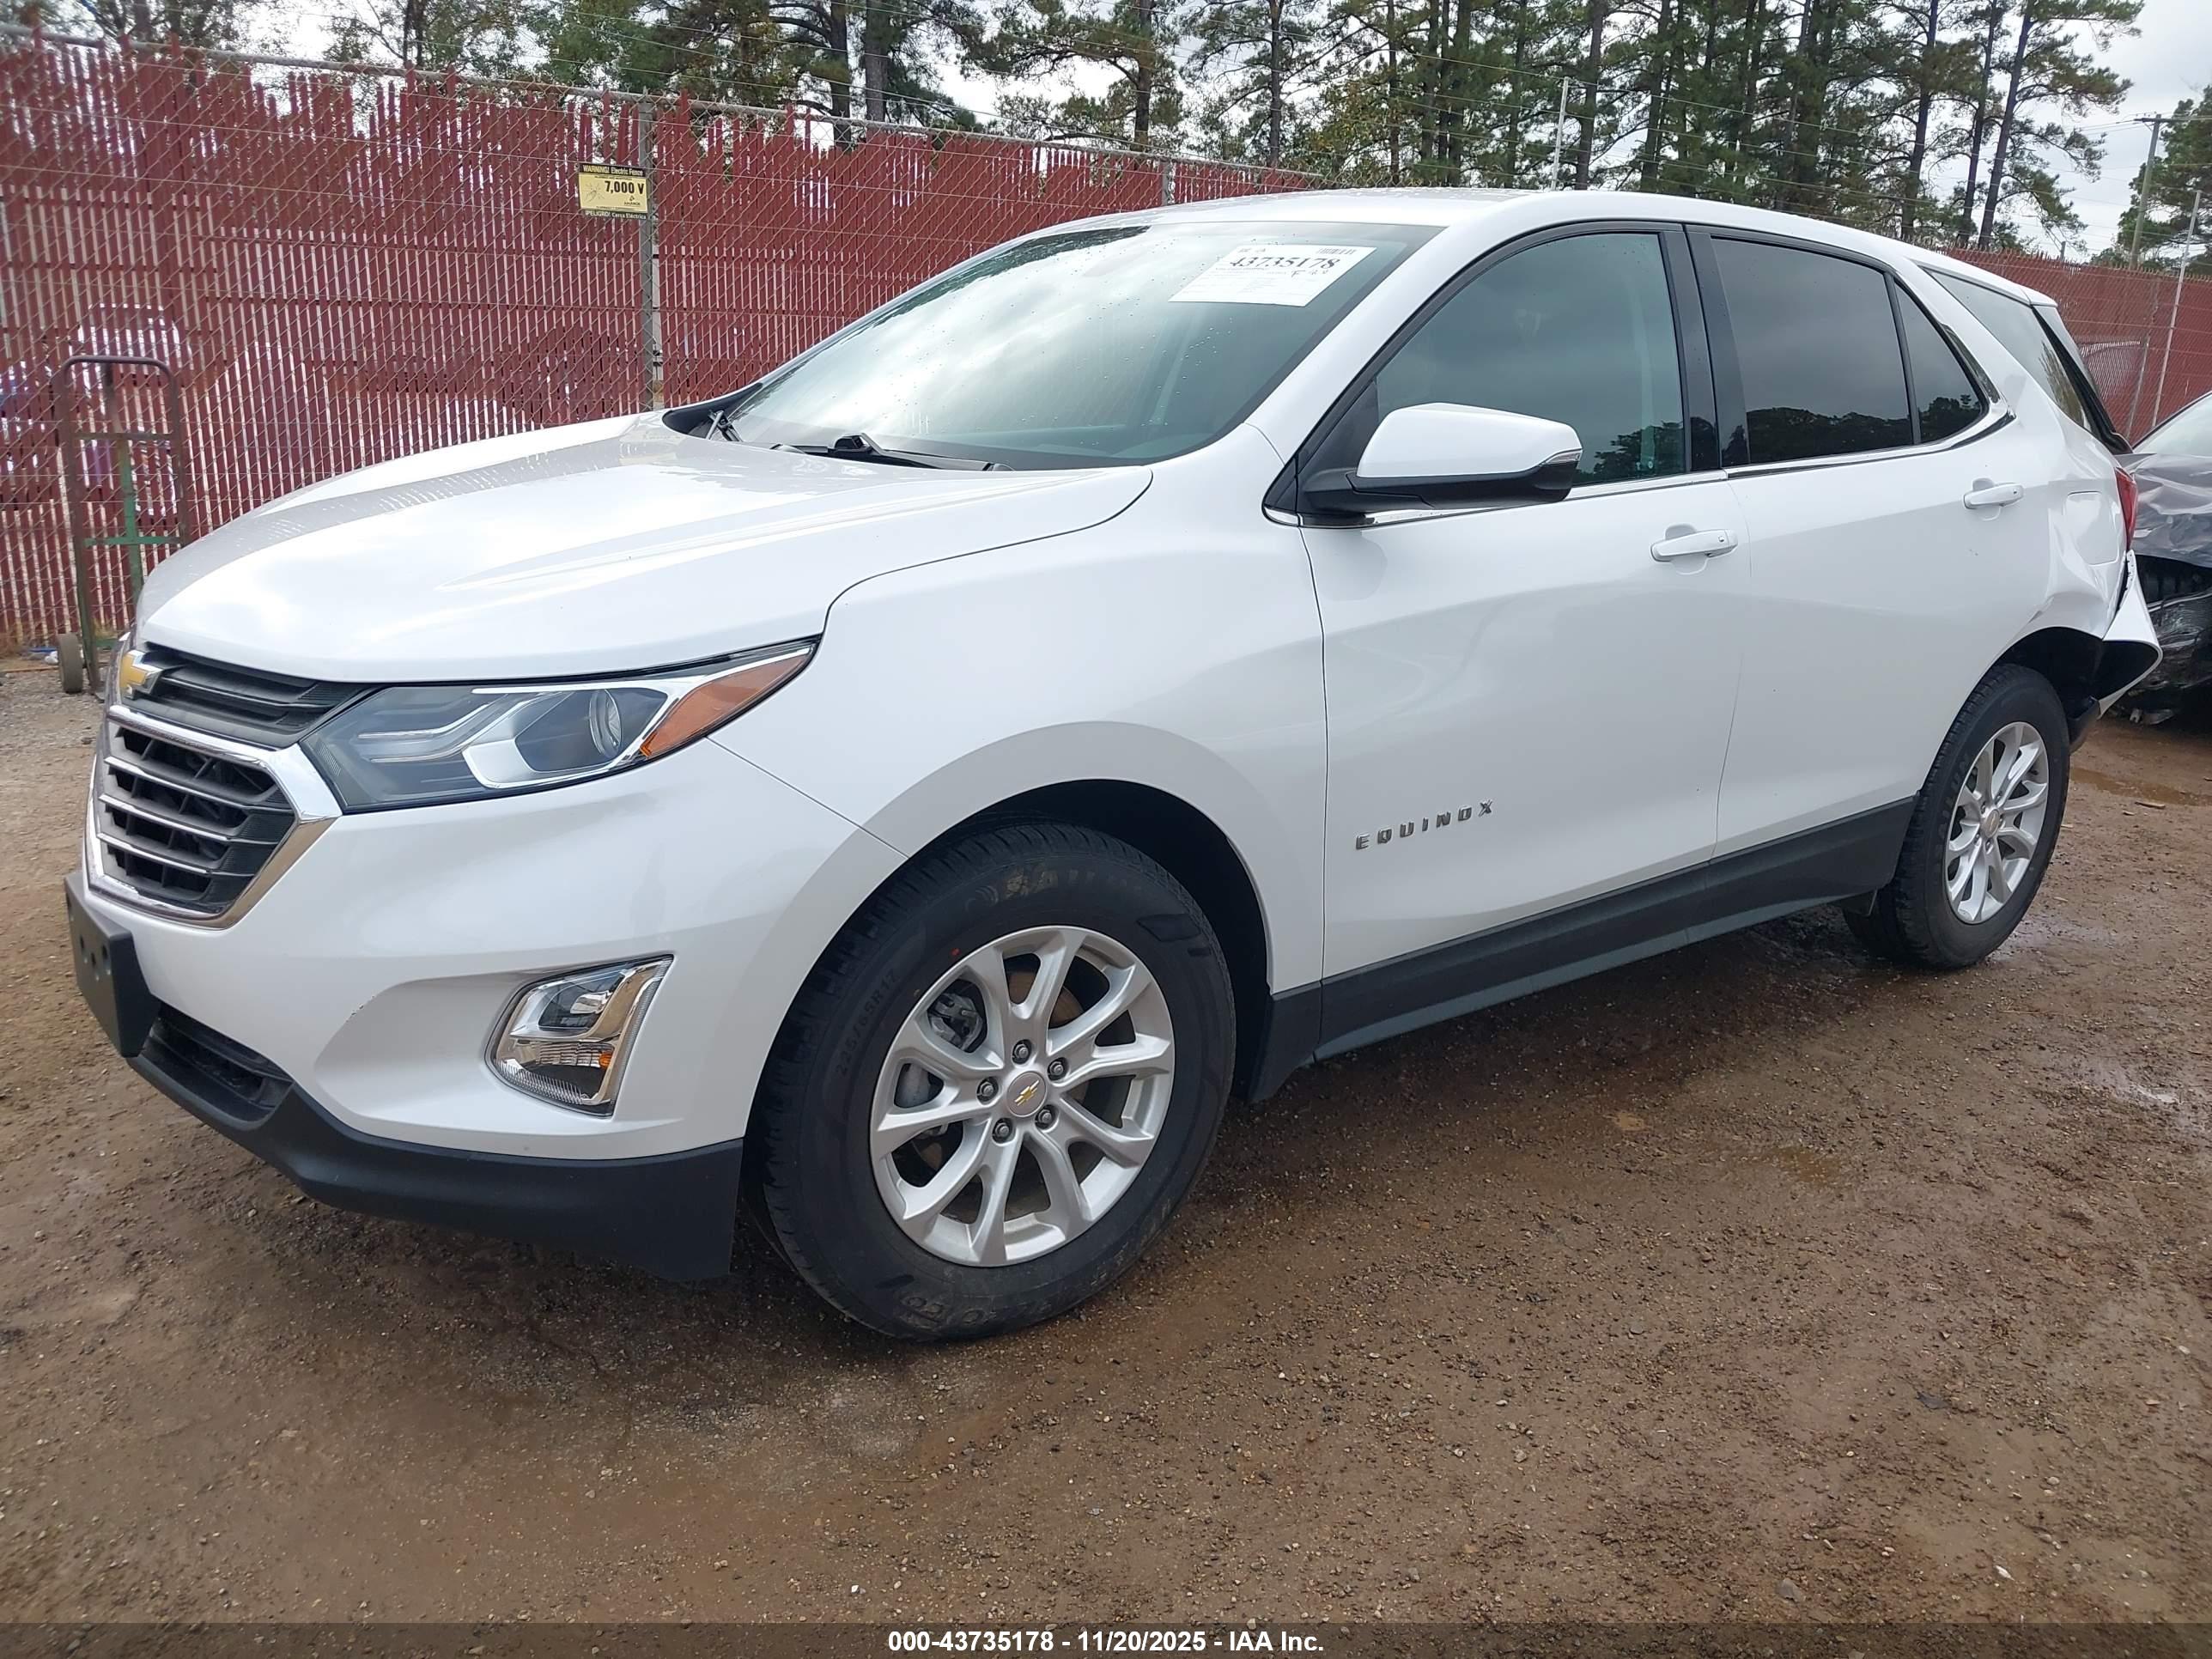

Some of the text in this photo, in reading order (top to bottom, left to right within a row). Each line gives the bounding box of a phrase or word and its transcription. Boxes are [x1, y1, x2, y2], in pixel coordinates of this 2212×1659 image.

[583, 164, 610, 173] WARNING!
[605, 180, 644, 194] 7,000 V
[1230, 257, 1340, 269] 43735178
[1356, 799, 1493, 850] EQUINOX
